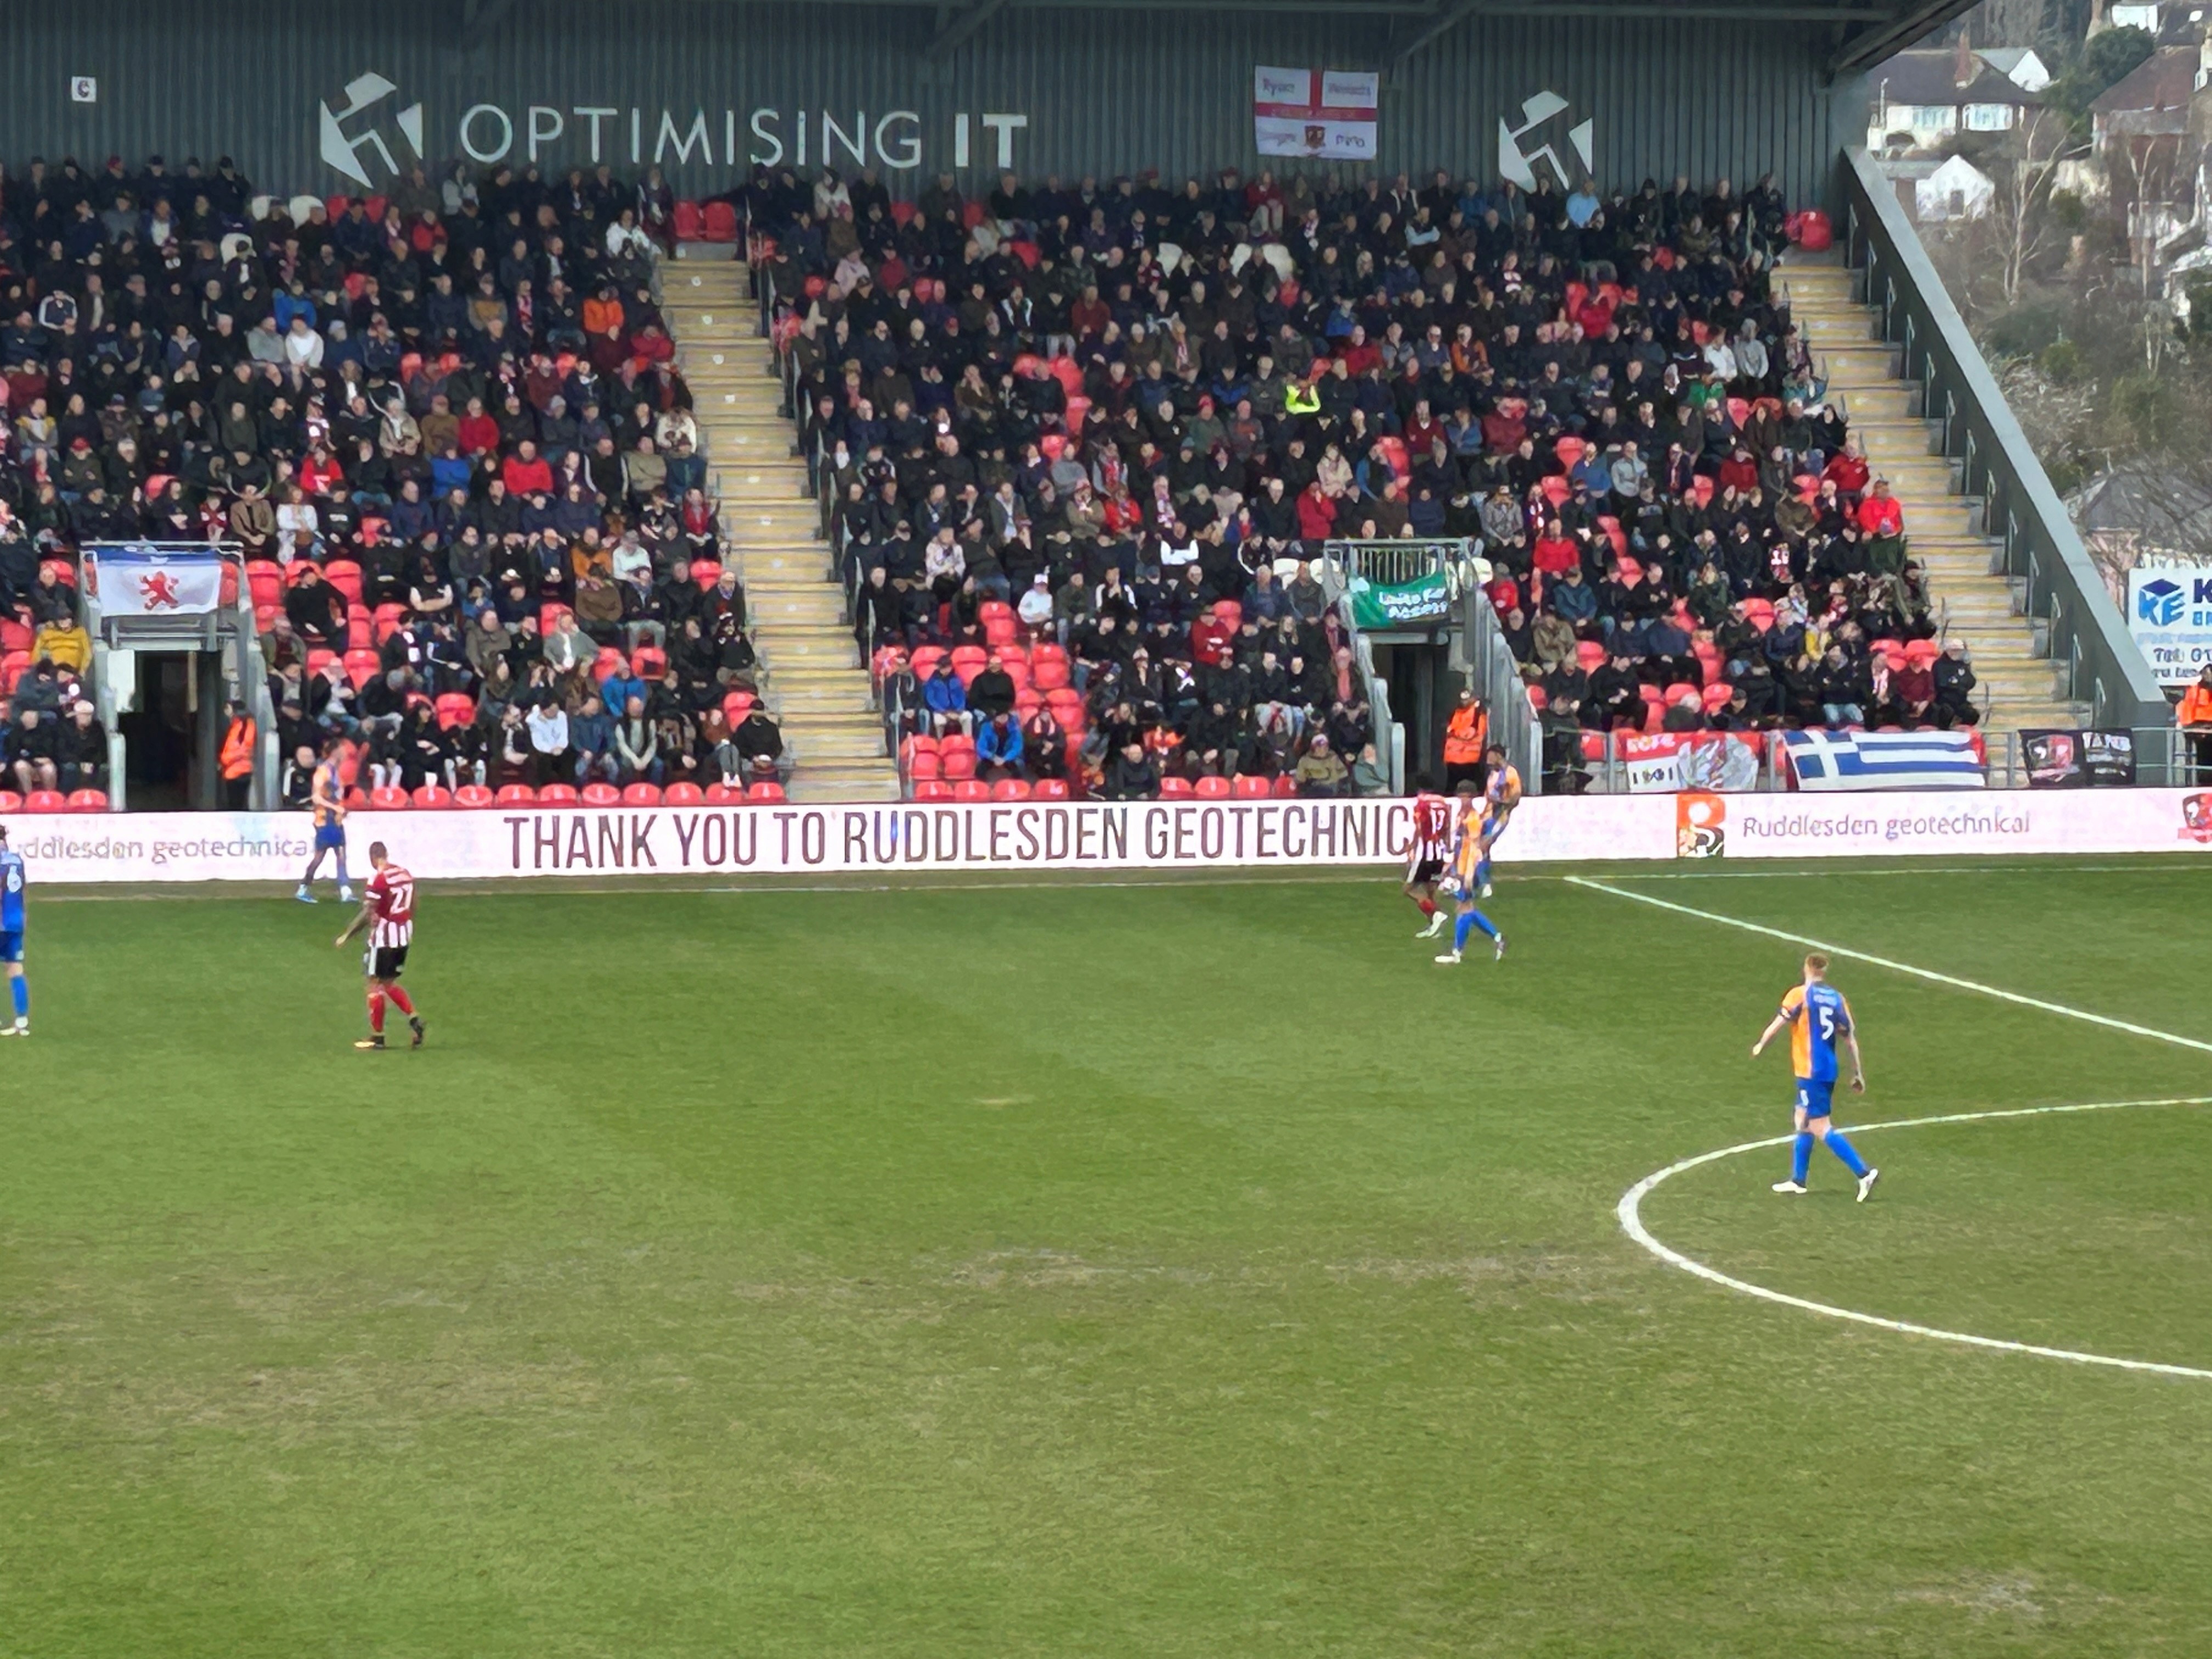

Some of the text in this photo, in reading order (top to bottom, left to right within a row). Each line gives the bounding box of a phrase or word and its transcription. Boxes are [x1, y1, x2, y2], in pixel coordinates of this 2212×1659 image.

[460, 103, 1028, 168] OPTIMISING IT
[503, 804, 1411, 869] THANK YOU TO RUDDLESDEN GEOTECHNIC
[1743, 806, 2031, 840] Ruddlesden geotechnical
[19, 836, 144, 860] ddlesden
[389, 882, 413, 915] 27
[1819, 1006, 1835, 1040] 5
